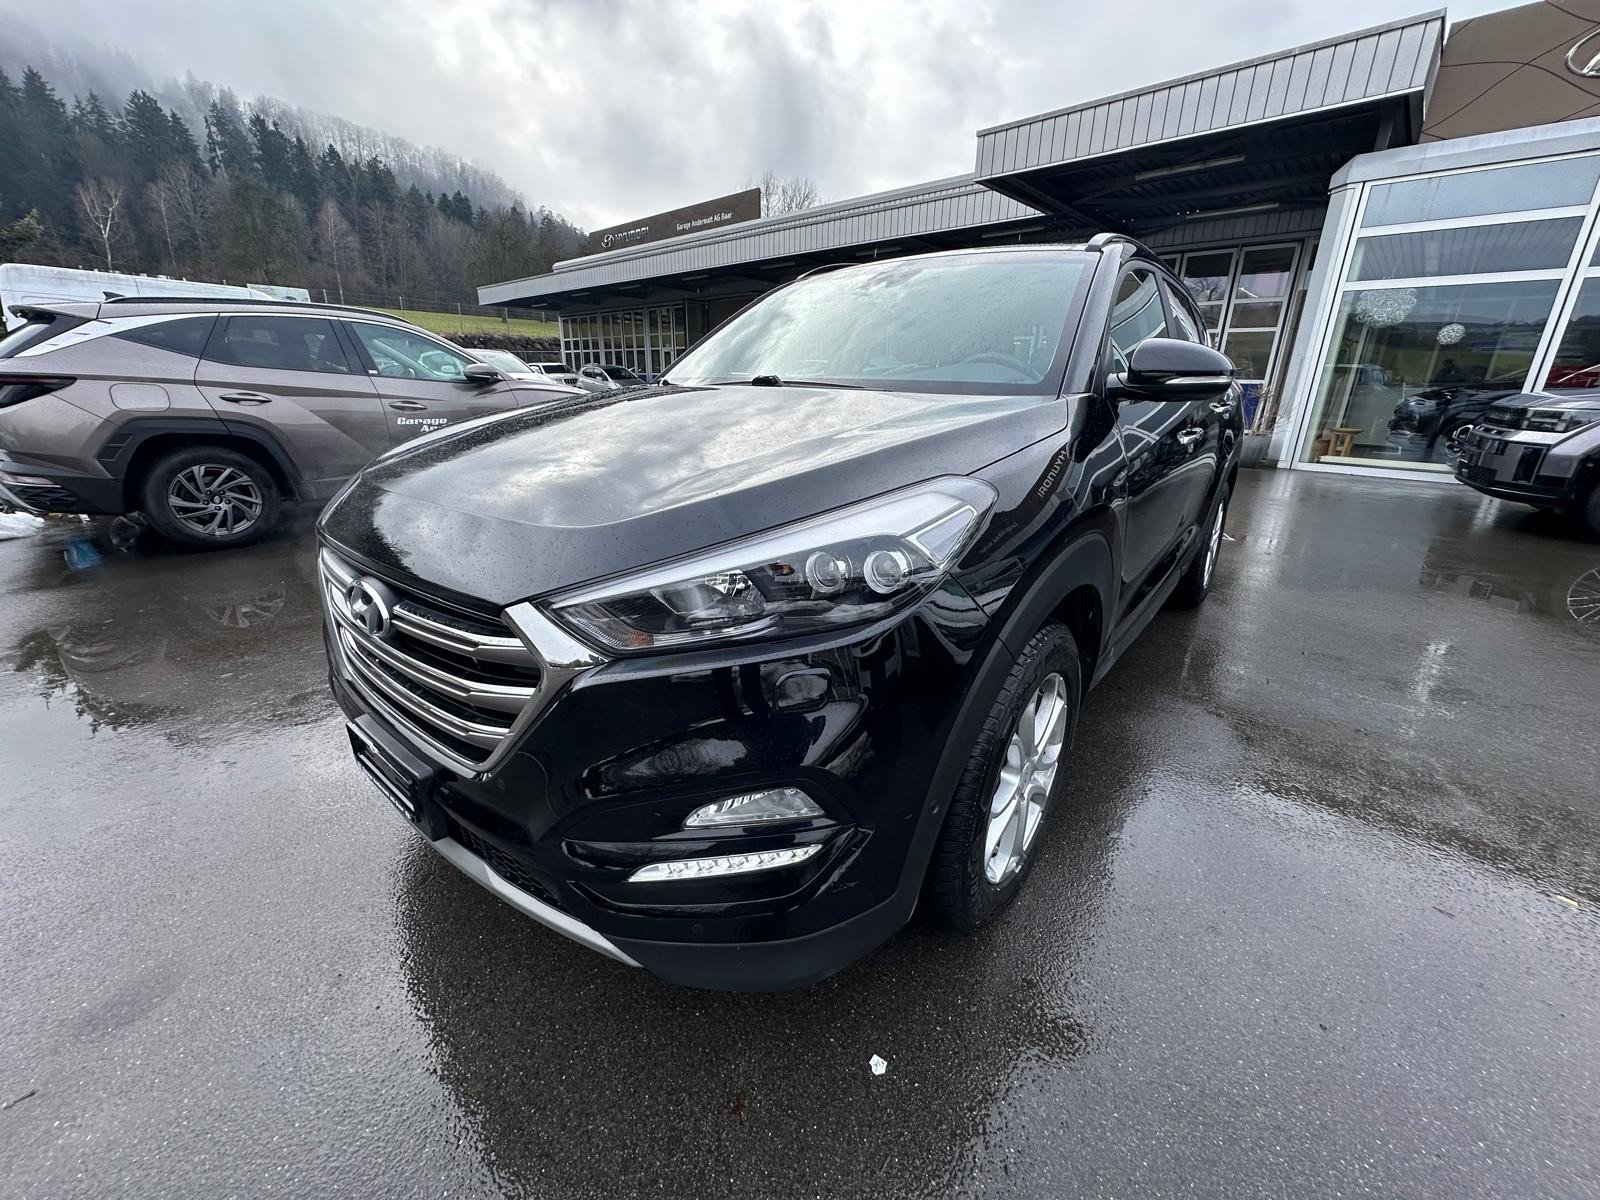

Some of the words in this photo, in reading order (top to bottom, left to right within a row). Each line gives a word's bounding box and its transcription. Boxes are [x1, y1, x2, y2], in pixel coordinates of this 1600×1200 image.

[676, 222, 691, 230] Garage
[691, 216, 714, 227] Andermatt
[714, 213, 721, 222] AG
[721, 212, 732, 221] Baar
[397, 417, 447, 425] Garage
